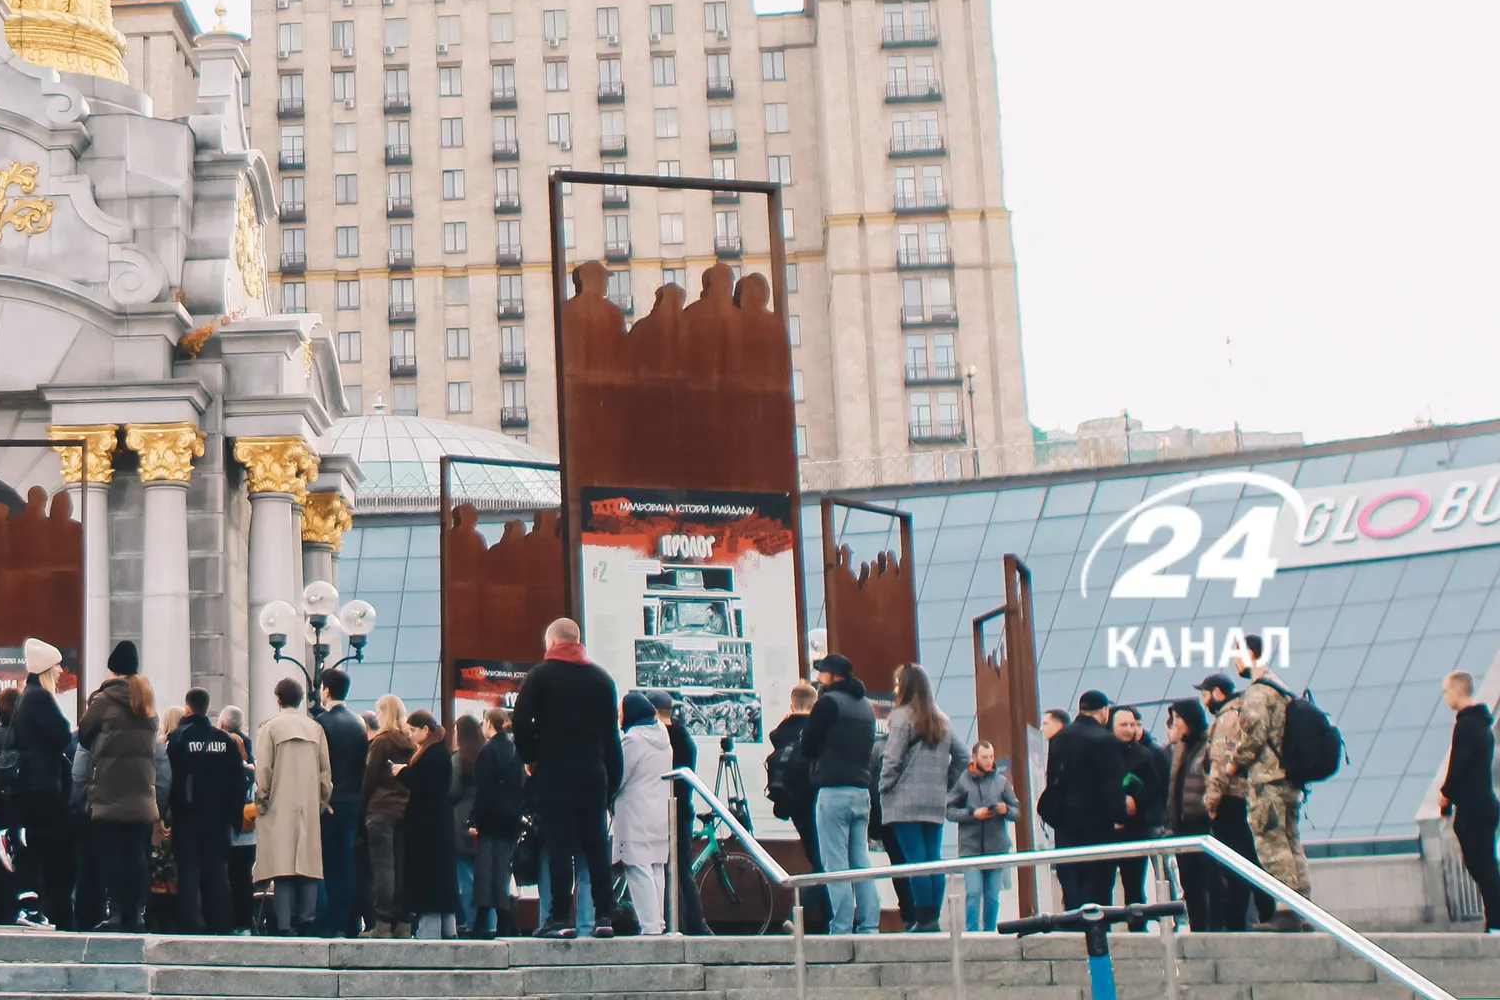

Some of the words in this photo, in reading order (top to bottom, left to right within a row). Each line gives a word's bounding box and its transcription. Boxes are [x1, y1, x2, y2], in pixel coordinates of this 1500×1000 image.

[619, 502, 674, 512] МАЛЬОВАНА
[675, 504, 710, 514] ІСТОРІЯ
[712, 505, 755, 515] МАЙДАНУ
[662, 534, 716, 558] ПРОЛОГ
